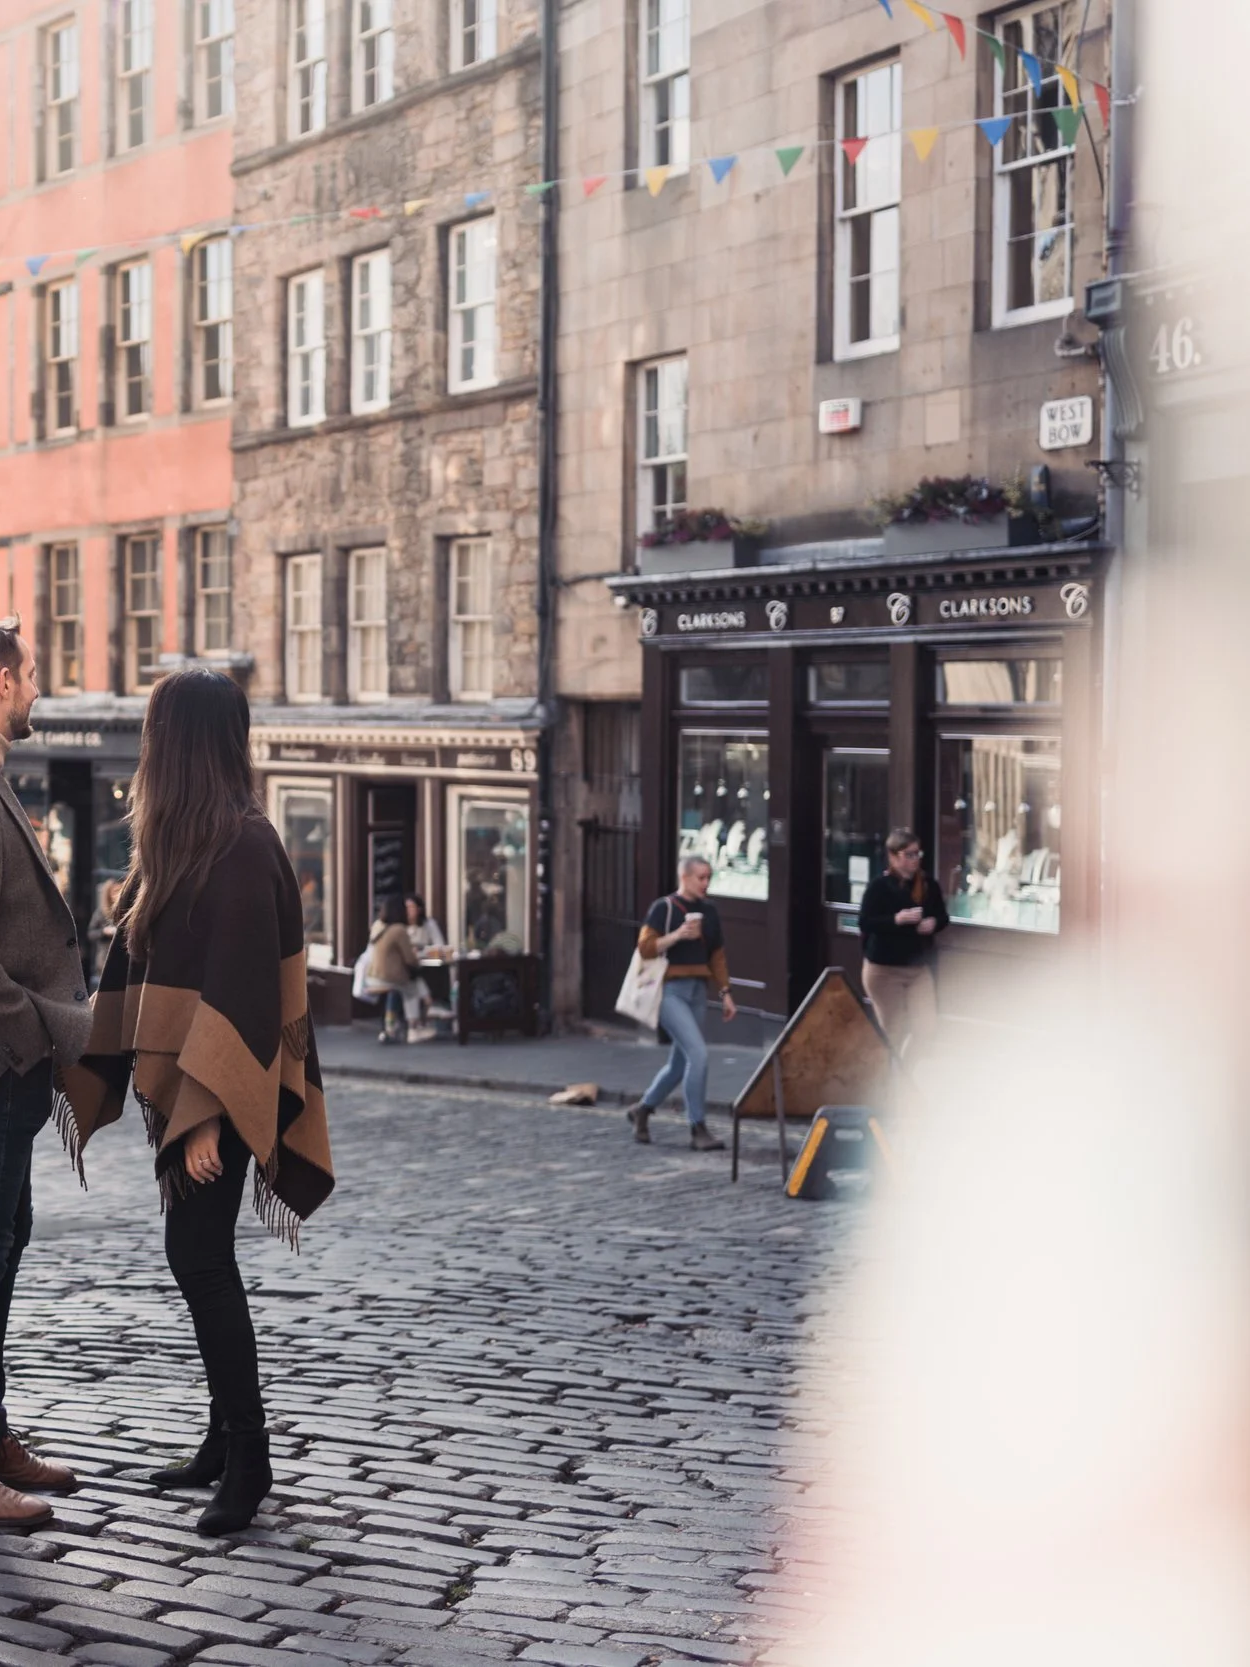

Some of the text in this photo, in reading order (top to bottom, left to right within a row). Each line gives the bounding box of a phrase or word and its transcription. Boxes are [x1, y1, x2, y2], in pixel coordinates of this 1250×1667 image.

[1046, 402, 1087, 421] WEST
[1048, 423, 1085, 444] BOW
[677, 611, 747, 631] CLARKSONS
[939, 595, 1033, 618] CLARKSONS
[510, 748, 537, 772] 89
